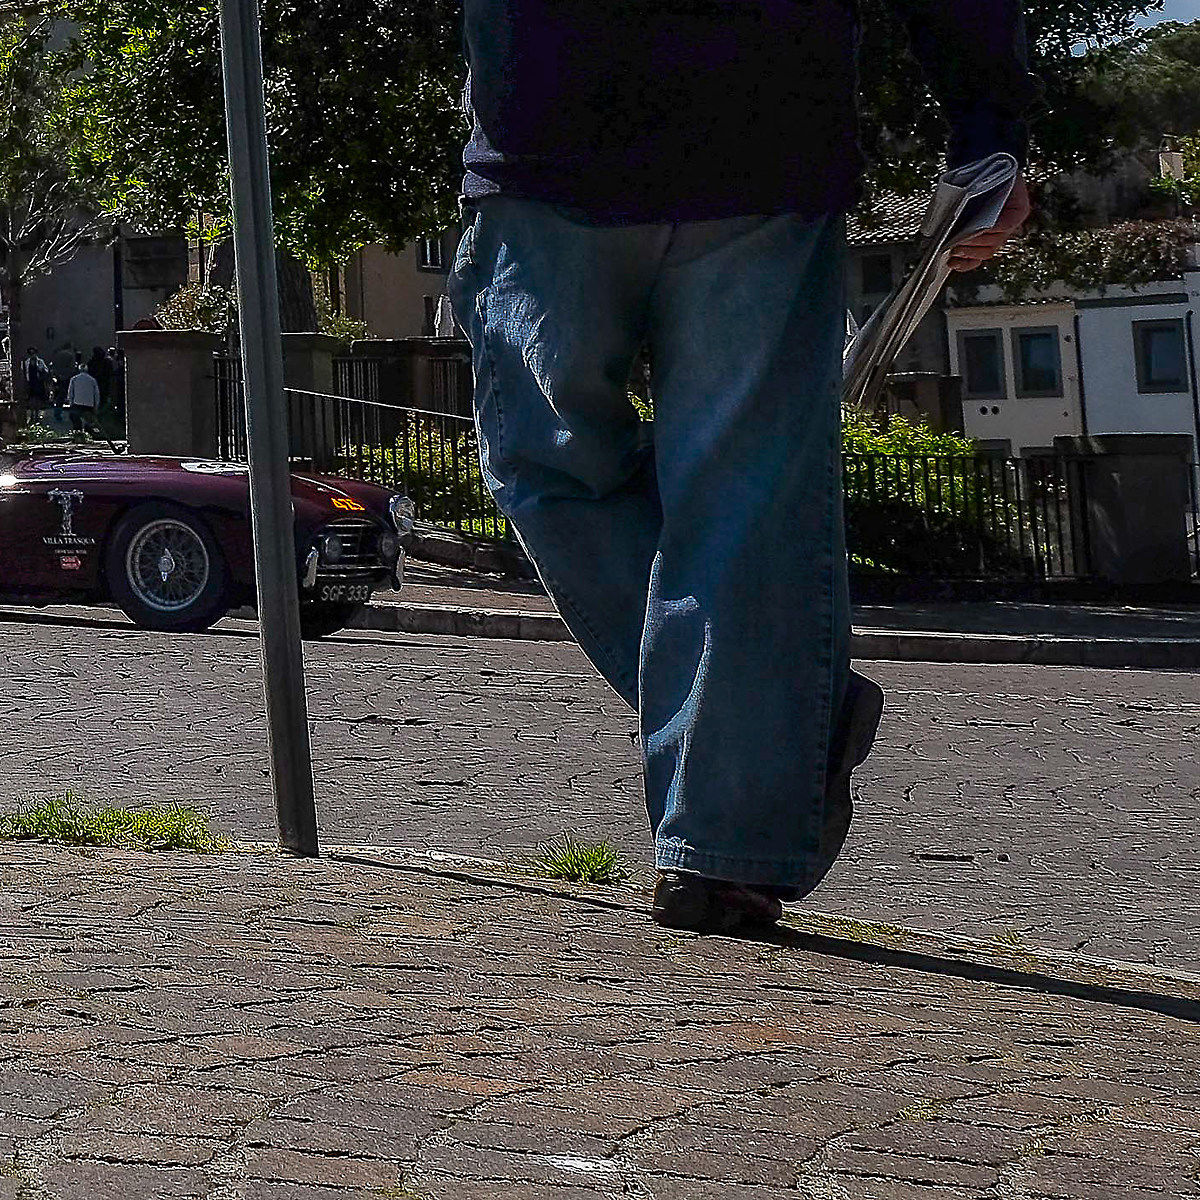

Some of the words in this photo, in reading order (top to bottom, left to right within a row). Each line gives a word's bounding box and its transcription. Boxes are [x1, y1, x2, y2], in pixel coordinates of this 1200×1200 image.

[43, 537, 64, 545] VILLA
[64, 537, 96, 546] TRASQUA
[321, 585, 346, 602] SGF
[347, 585, 369, 601] 333
